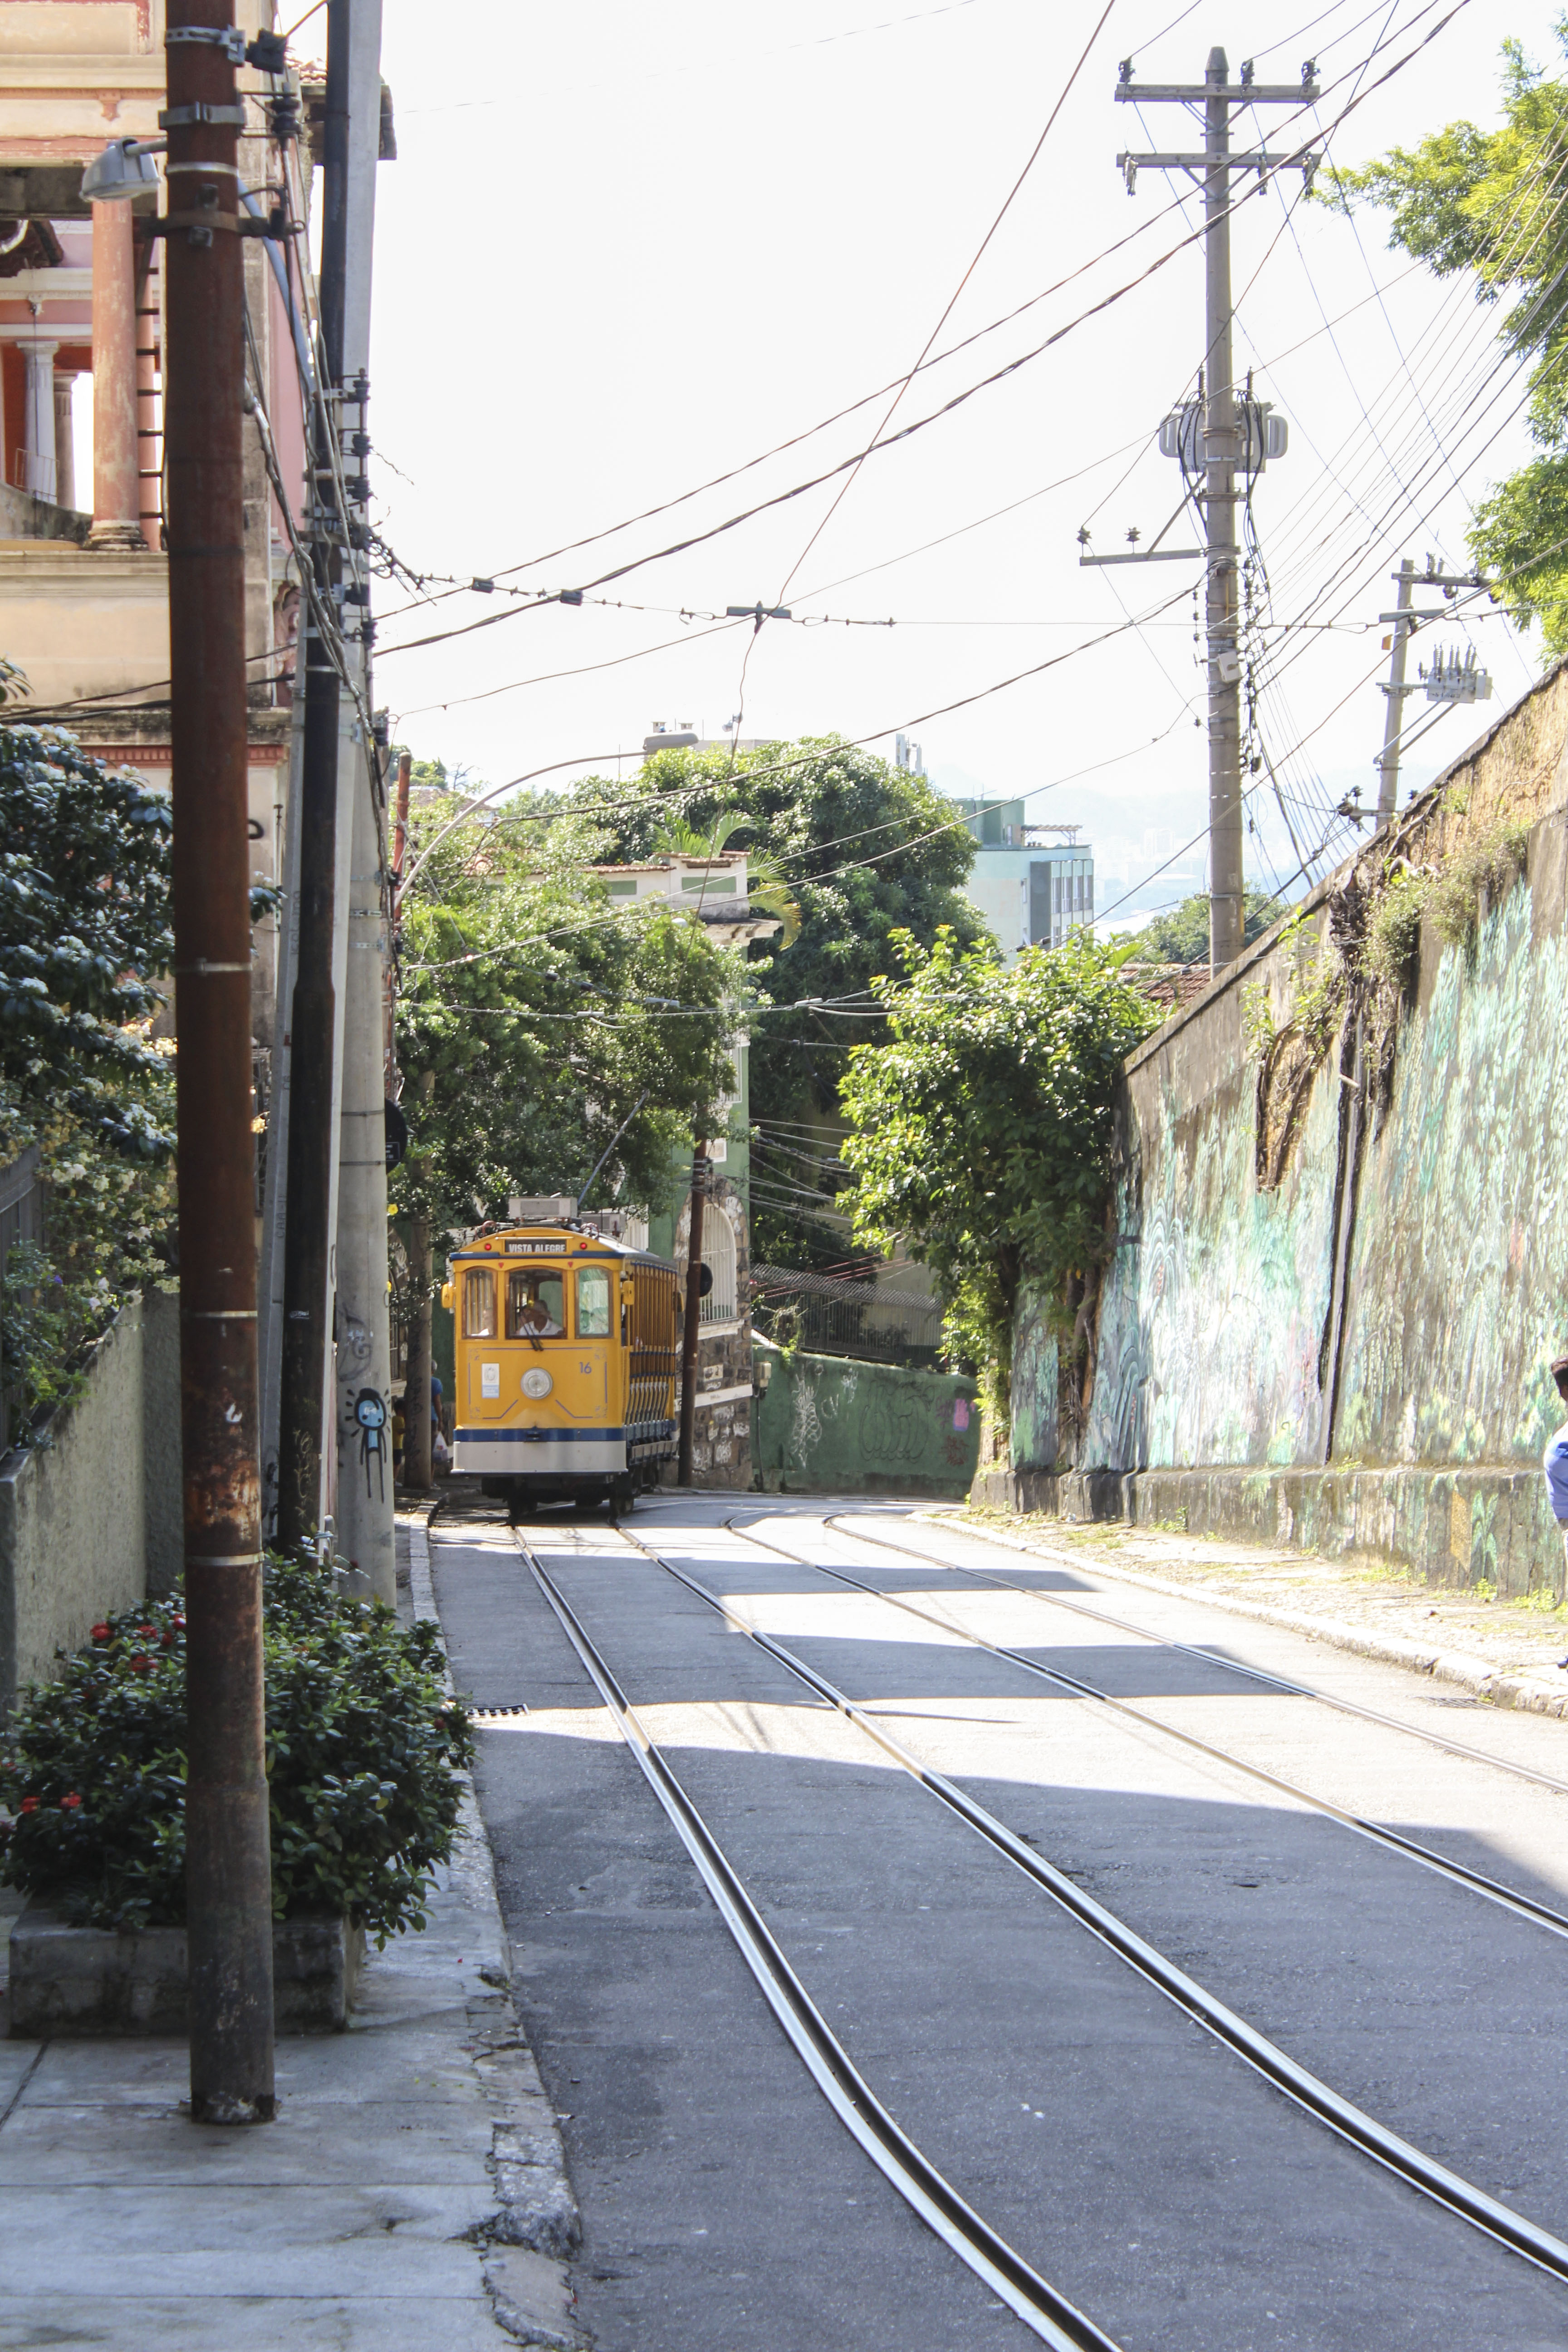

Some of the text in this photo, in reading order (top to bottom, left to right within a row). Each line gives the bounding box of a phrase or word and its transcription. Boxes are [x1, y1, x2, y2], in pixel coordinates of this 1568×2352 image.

[509, 1244, 565, 1252] VISTA ALEGRE
[579, 1362, 592, 1374] 16
